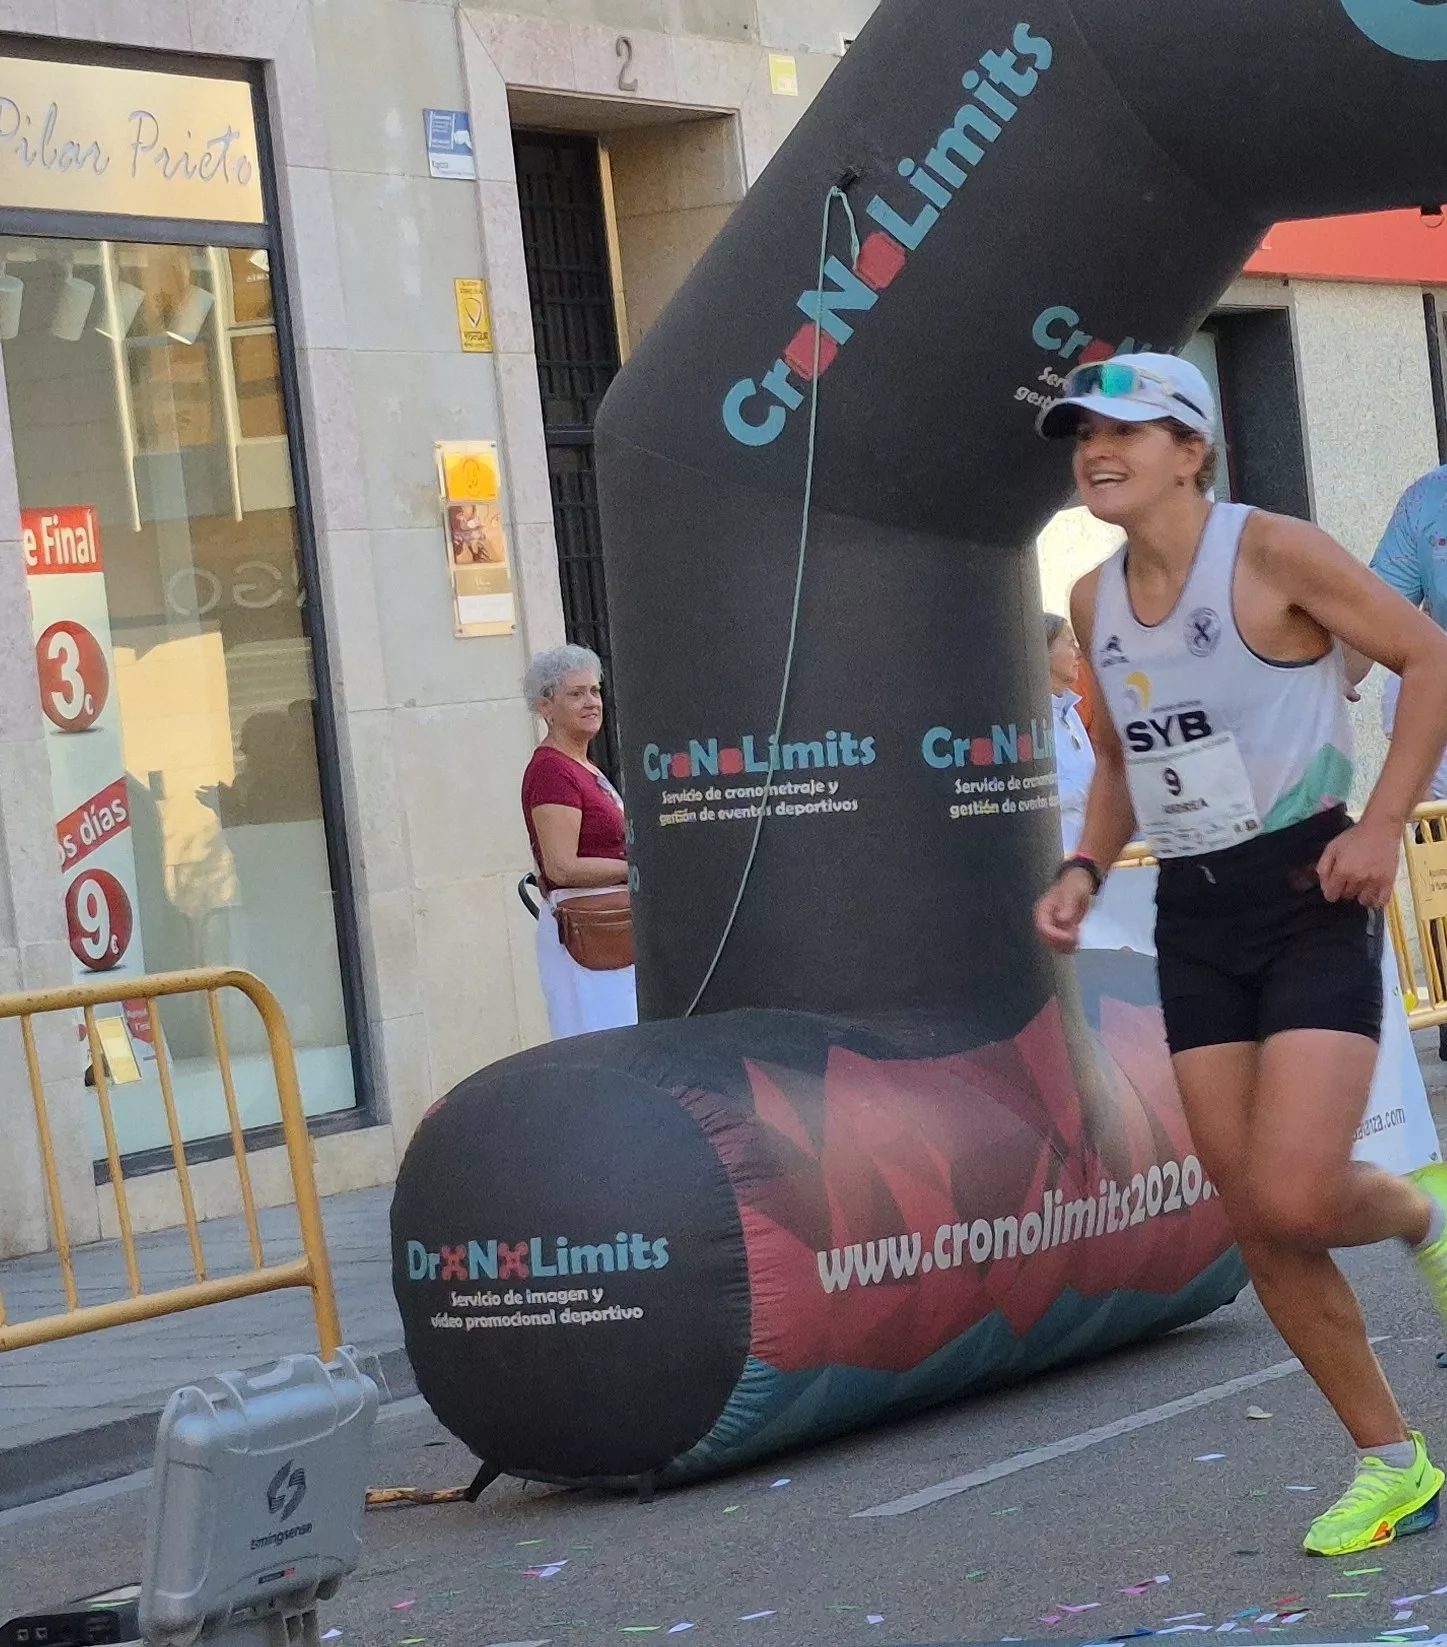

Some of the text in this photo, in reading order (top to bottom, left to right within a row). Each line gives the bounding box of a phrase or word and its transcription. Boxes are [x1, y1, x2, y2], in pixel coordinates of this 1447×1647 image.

[615, 36, 638, 91] 2
[0, 96, 252, 185] Pilar Prieto
[41, 512, 97, 566] Final
[1126, 710, 1213, 753] SYB
[661, 779, 839, 805] Servicio de cronometraje y
[955, 777, 1005, 795] Servicio
[1007, 774, 1021, 791] de
[1163, 767, 1182, 796] 9
[80, 798, 127, 845] días
[699, 806, 716, 822] de
[718, 804, 772, 820] eventos
[775, 798, 859, 818] deportivos
[950, 799, 999, 820] gestión
[1002, 797, 1017, 814] de
[817, 1153, 1220, 1294] www.cronolimits2020.
[450, 1286, 604, 1307] Servicio de imagen y
[465, 1308, 557, 1331] promocional
[559, 1303, 645, 1325] deportivo
